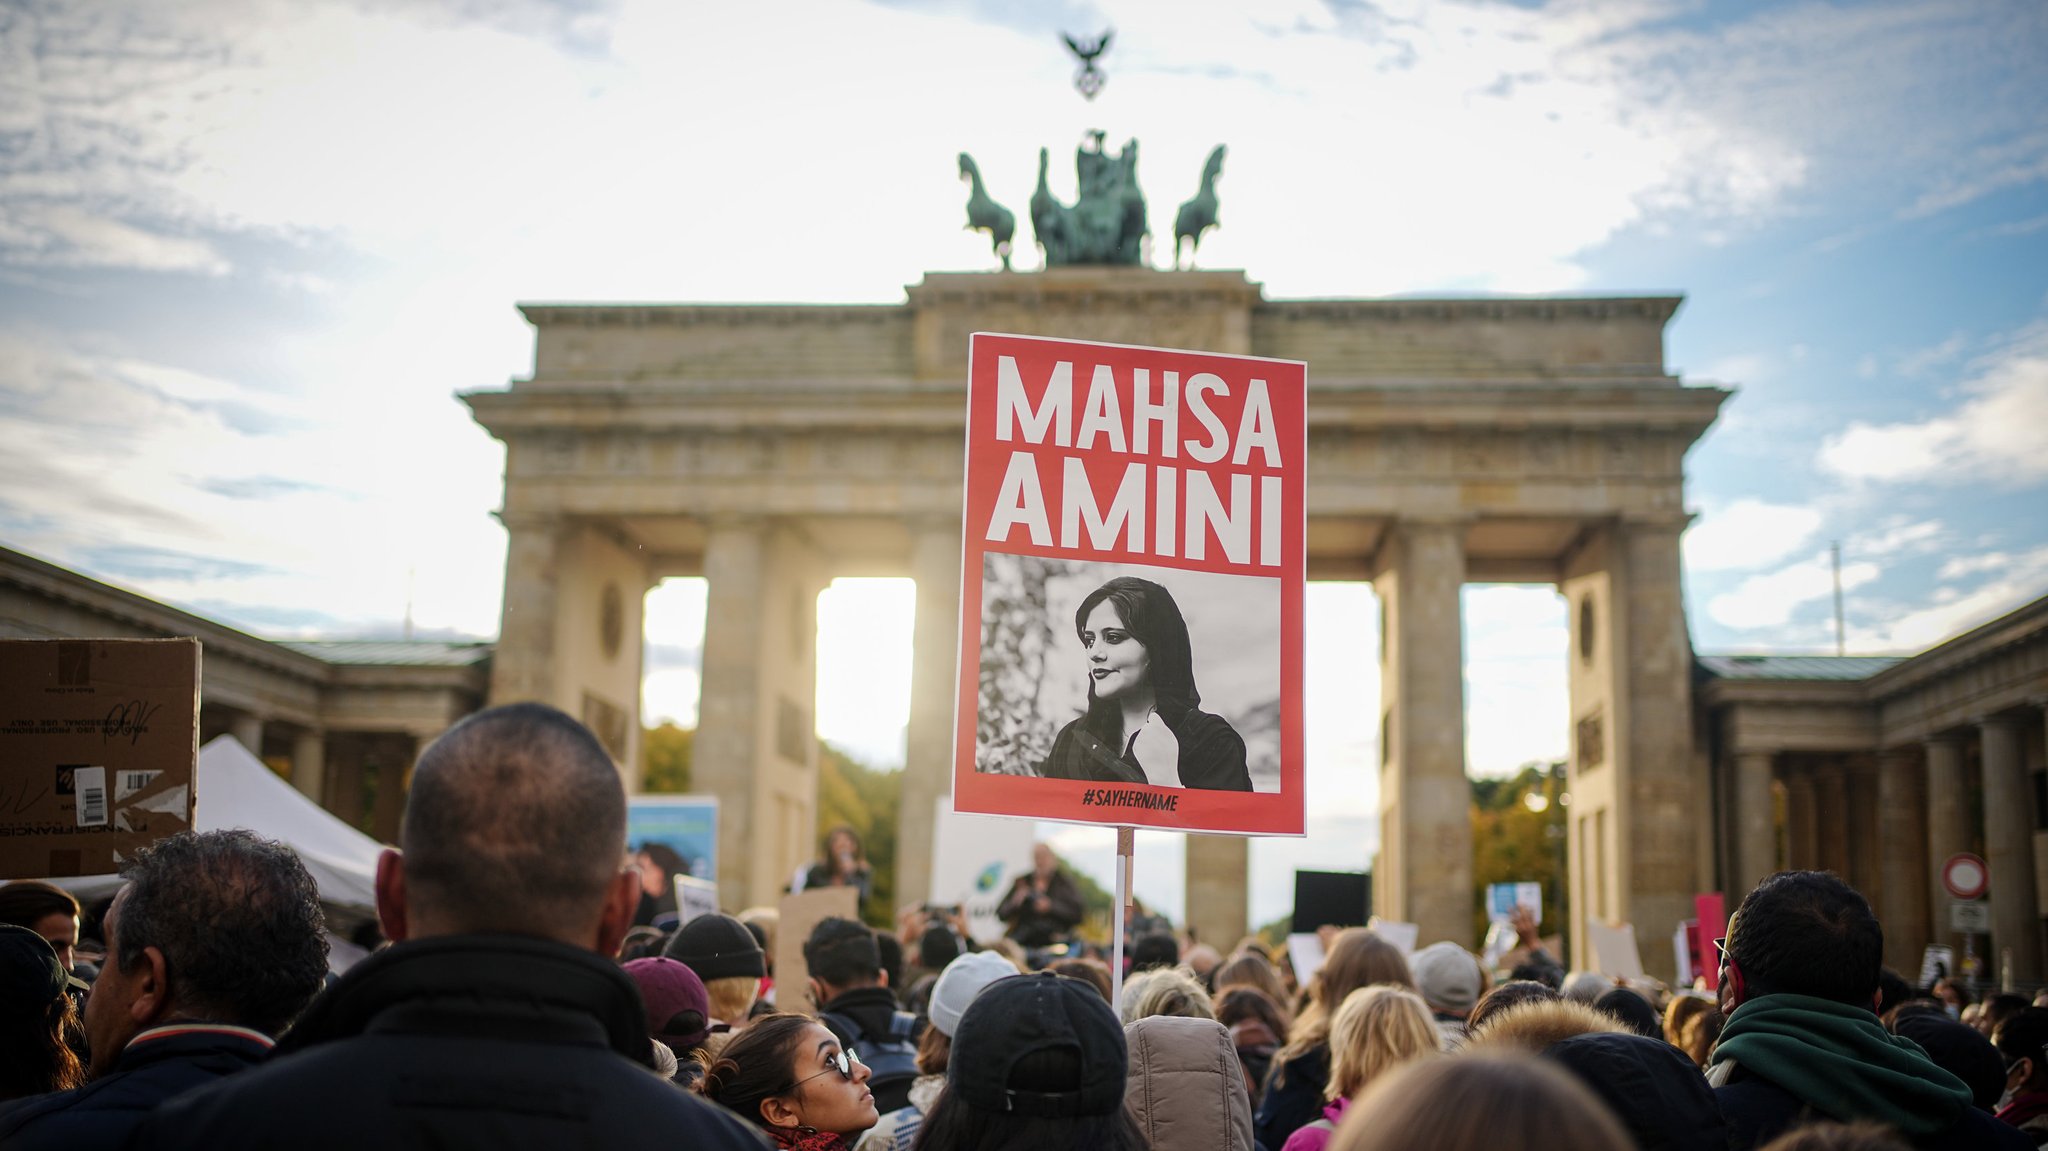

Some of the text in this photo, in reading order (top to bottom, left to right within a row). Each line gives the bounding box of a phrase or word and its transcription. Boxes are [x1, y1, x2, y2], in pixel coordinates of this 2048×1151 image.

[996, 355, 1283, 468] MAHSA
[985, 451, 1282, 567] AMINI
[10, 719, 131, 727] PROFESSIONAL USE ONLY
[1082, 788, 1179, 811] #SAYHERNAME
